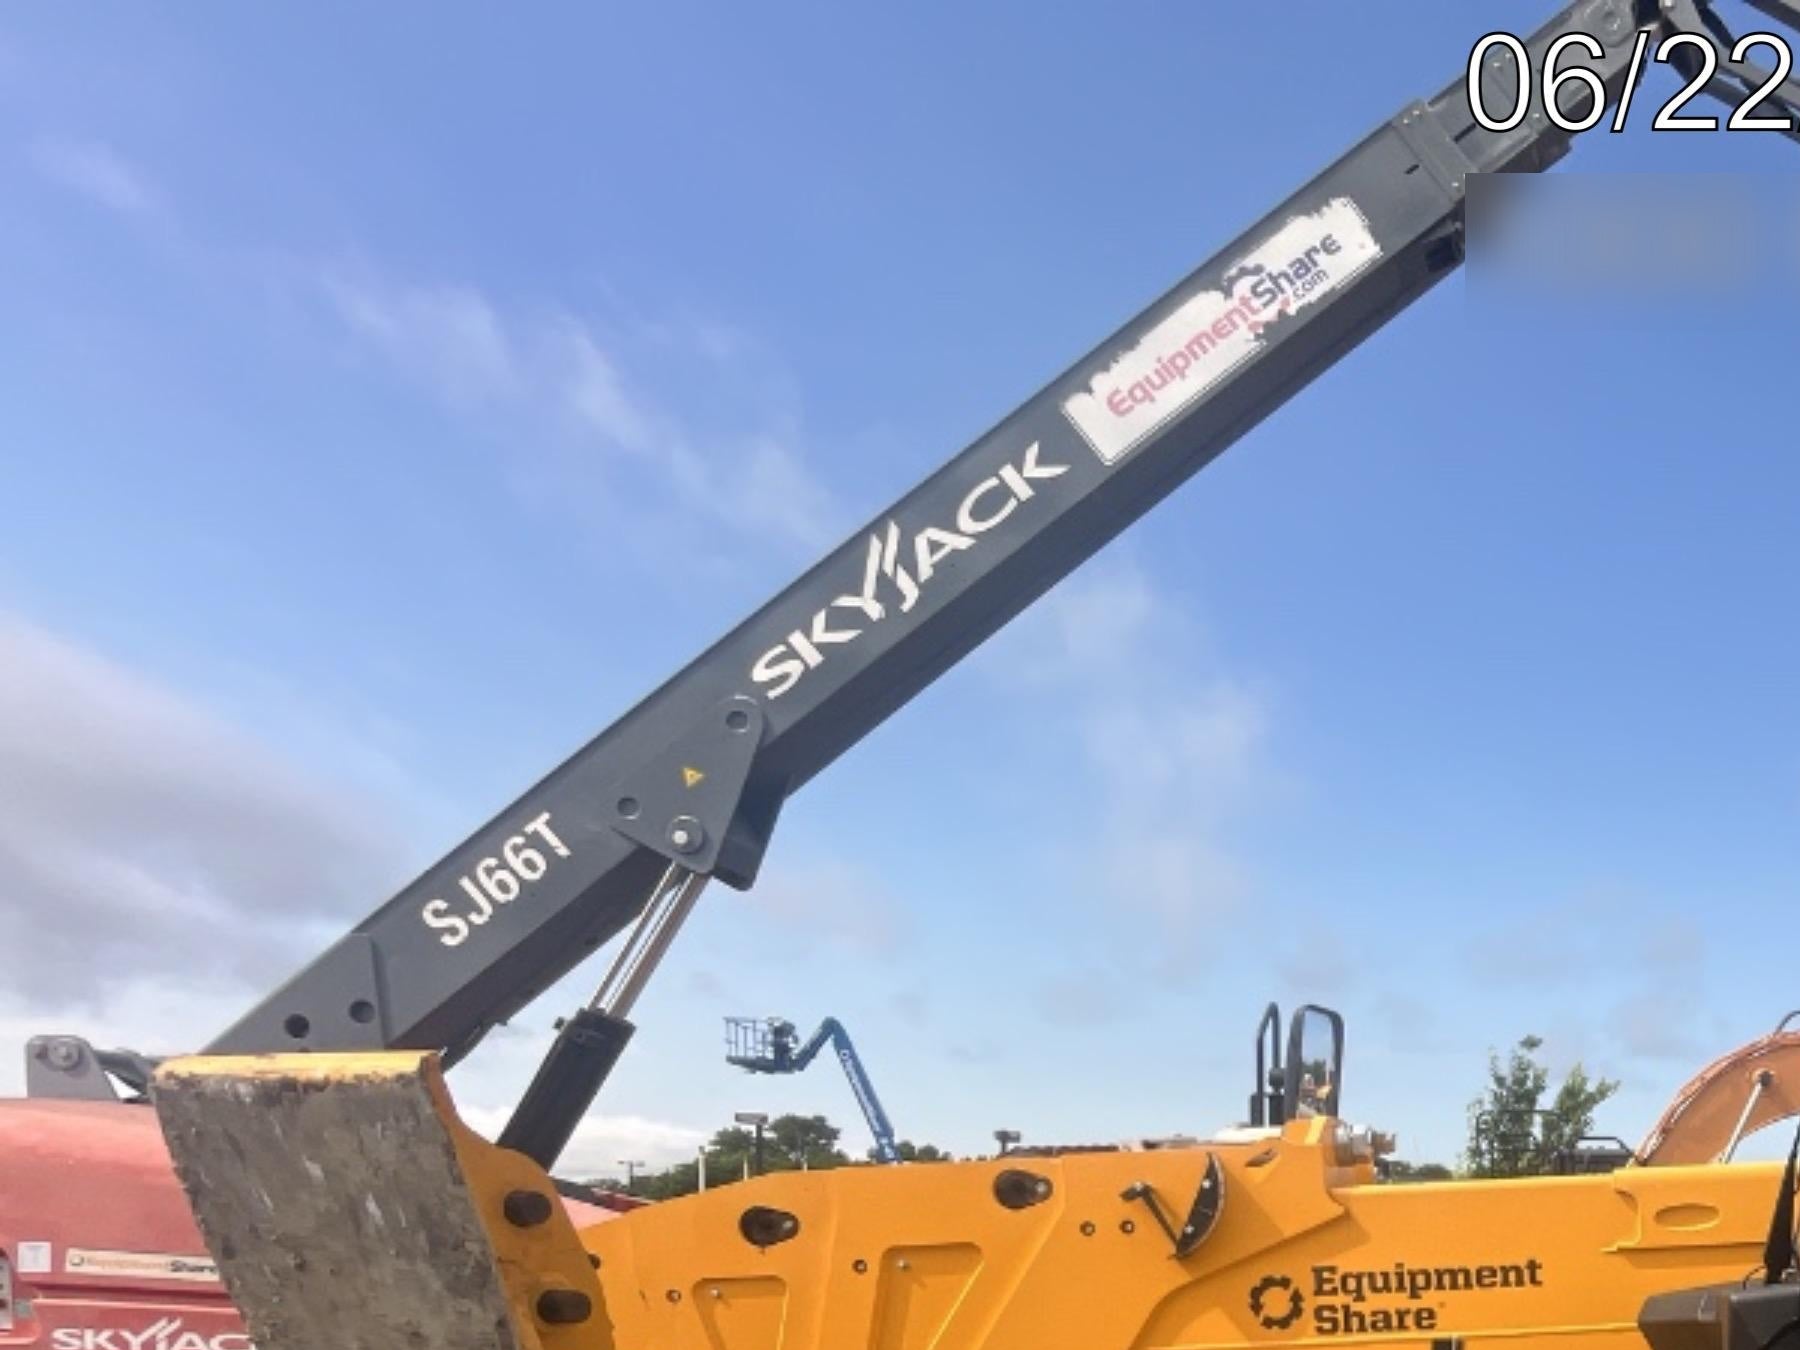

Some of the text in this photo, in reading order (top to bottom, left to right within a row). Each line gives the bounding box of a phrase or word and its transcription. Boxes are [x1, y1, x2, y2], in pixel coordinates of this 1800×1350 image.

[750, 440, 1071, 700] SKYJACK
[421, 811, 573, 947] SJ66T
[1312, 1259, 1543, 1302] Equipment
[1314, 1304, 1437, 1335] Share
